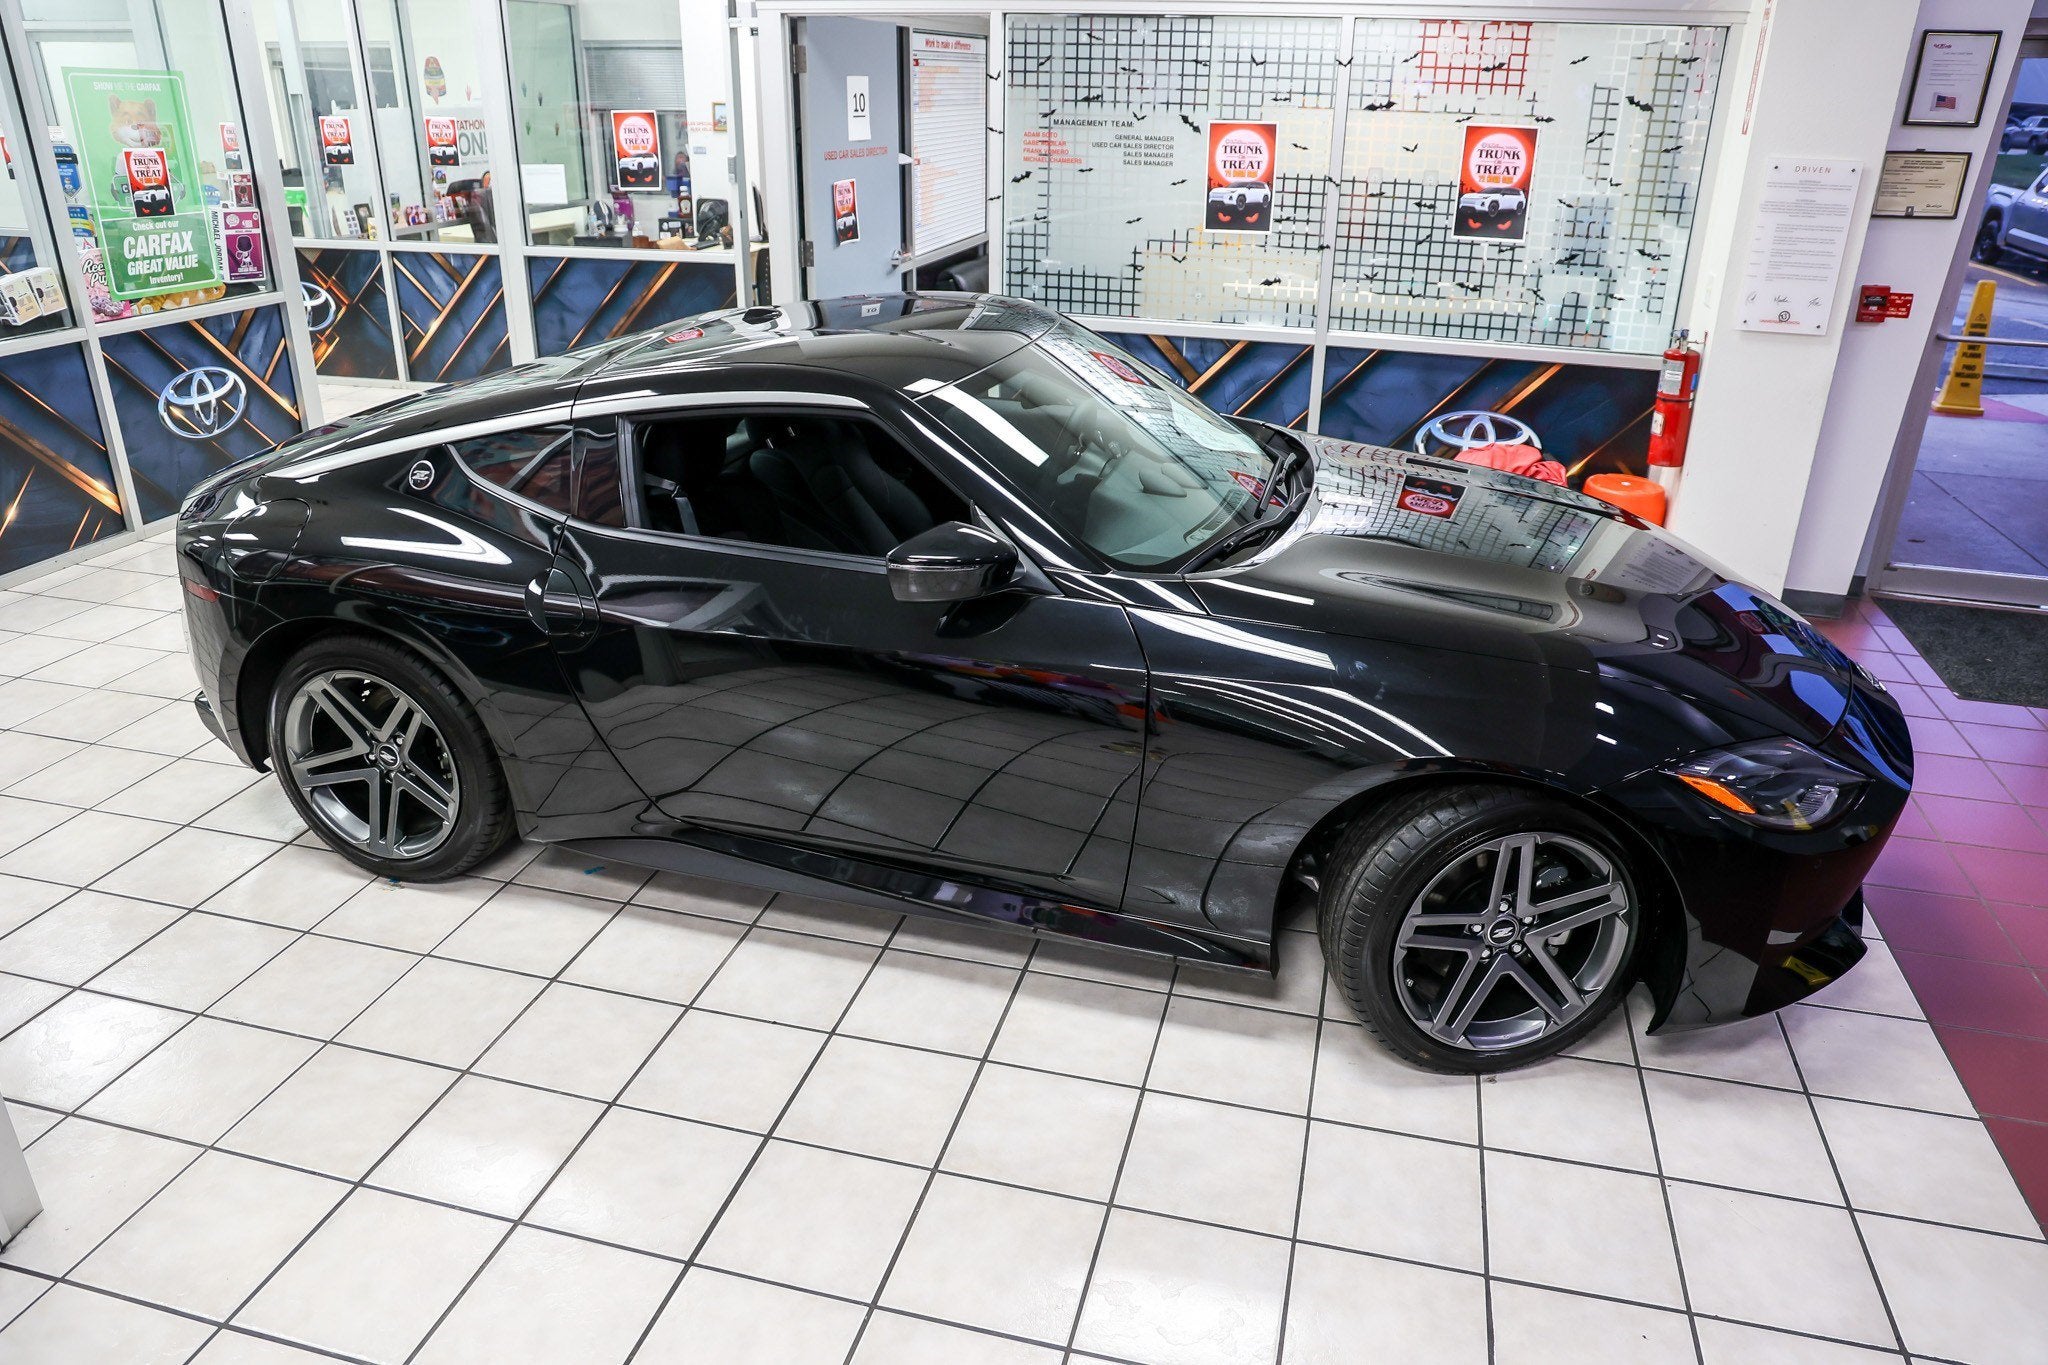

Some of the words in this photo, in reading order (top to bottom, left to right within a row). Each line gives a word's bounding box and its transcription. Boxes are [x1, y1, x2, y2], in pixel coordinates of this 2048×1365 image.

[93, 82, 113, 90] SHOW
[136, 83, 161, 91] CARFAX
[853, 93, 866, 112] 10
[1053, 119, 1107, 127] MANAGEMENT
[1111, 120, 1135, 128] TEAM:
[459, 131, 488, 156] ON!
[824, 150, 837, 160] USED
[839, 149, 848, 159] CAR
[850, 148, 865, 158] SALES
[866, 146, 888, 157] DIRECTOR
[1222, 145, 1263, 154] TRUNK
[1477, 149, 1521, 160] TRUNK
[133, 158, 160, 166] TRUNK
[1221, 160, 1263, 169] TREAT
[135, 169, 161, 178] TREAT
[1476, 164, 1520, 175] TREAT
[1795, 165, 1831, 174] DRIVEN
[132, 221, 155, 231] Check
[155, 221, 167, 229] out
[167, 220, 179, 228] our
[211, 211, 221, 240] MICHAEL
[123, 230, 194, 259] CARFAX
[214, 243, 223, 271] JORDAN
[127, 257, 164, 276] GREAT
[165, 254, 199, 271] VALUE
[149, 272, 184, 285] Inventory!
